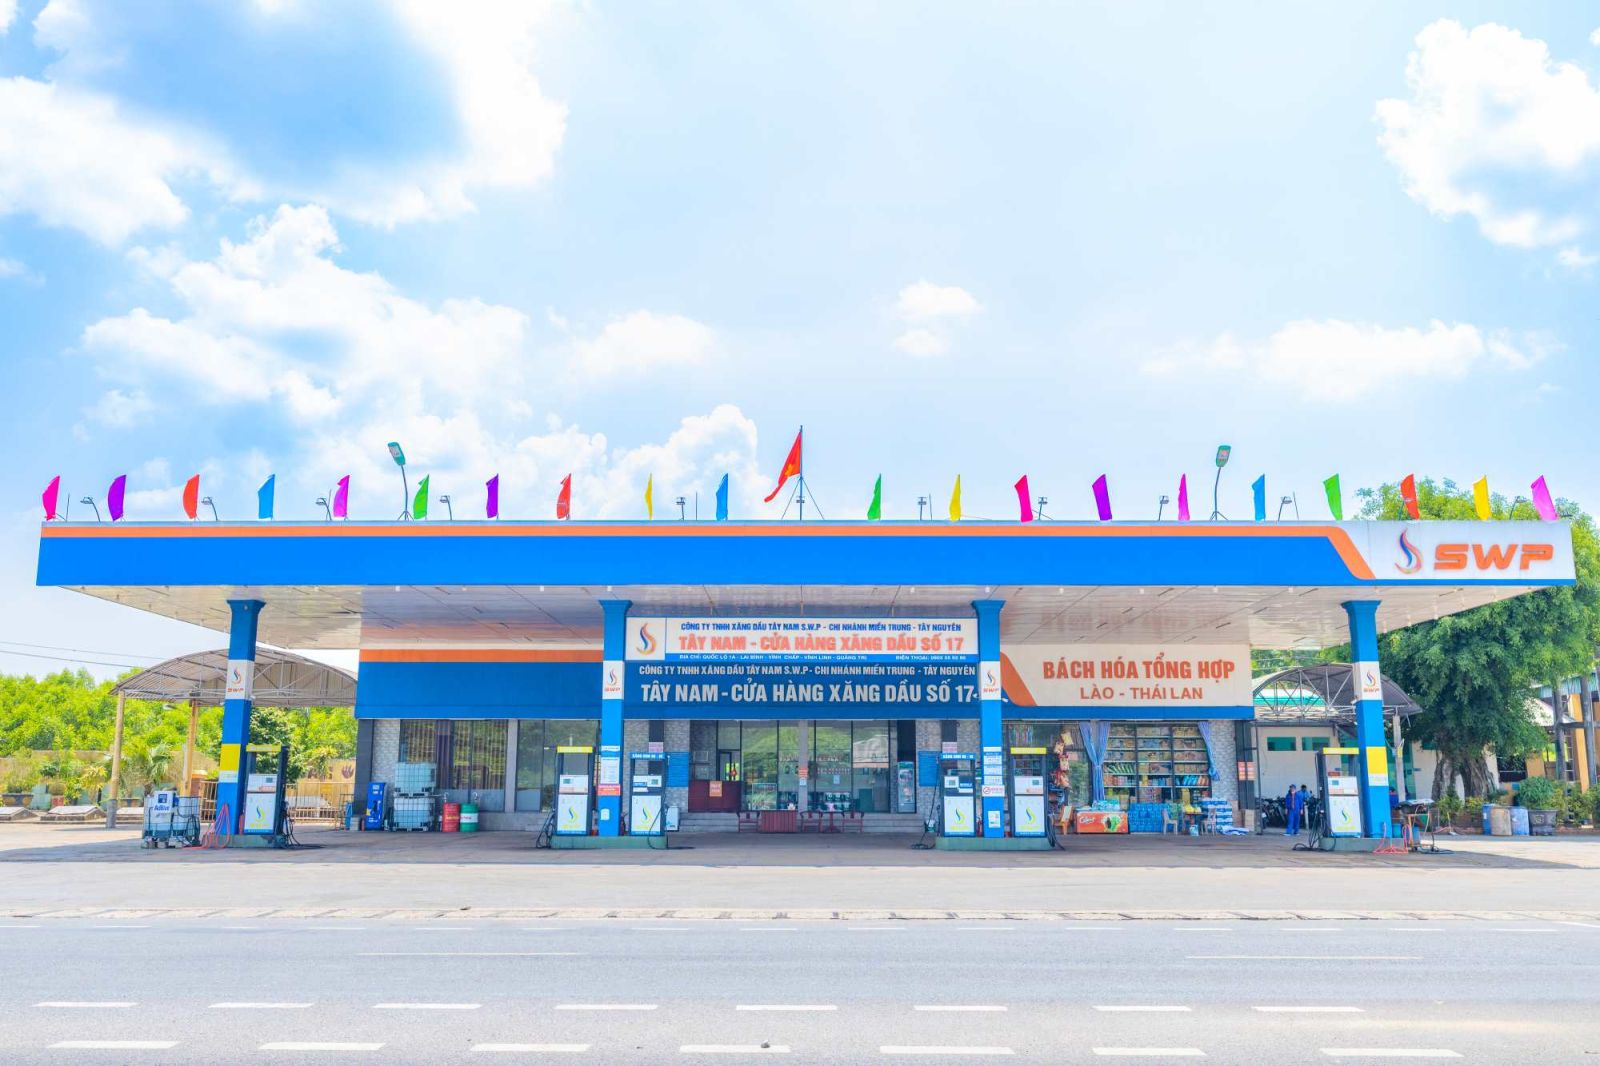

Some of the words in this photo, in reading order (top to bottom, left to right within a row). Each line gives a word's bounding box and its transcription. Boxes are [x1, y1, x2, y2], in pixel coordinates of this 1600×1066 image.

[1434, 543, 1554, 570] SWP
[681, 622, 700, 631] CÔNG
[701, 622, 710, 631] TY
[712, 622, 730, 631] TNHH
[731, 622, 751, 631] XĂNG
[768, 622, 781, 631] TÂY
[783, 622, 799, 631] NAM
[801, 622, 821, 631] S.W.P
[828, 622, 840, 631] CHI
[842, 622, 867, 631] NHÁNH
[888, 622, 911, 631] TRUNG
[917, 622, 931, 631] TÂY
[932, 622, 961, 631] NGUYÊN
[679, 633, 706, 650] TÂY
[711, 636, 747, 650] NAM
[760, 632, 791, 651] CỬA
[795, 633, 837, 651] HÀNG
[840, 633, 883, 651] XĂNG
[920, 633, 943, 651] SỐ
[946, 637, 964, 651] 17
[639, 665, 662, 675] CÔNG
[664, 665, 675, 675] TY
[677, 665, 700, 675] TNHH
[701, 665, 725, 675] XĂNG
[746, 665, 760, 675] TÂY
[761, 665, 782, 675] NAM
[814, 665, 830, 675] CHI
[831, 665, 861, 675] NHÁNH
[886, 665, 915, 675] TRUNG
[923, 665, 937, 675] TÂY
[939, 665, 976, 675] NGUYÊN
[1043, 657, 1096, 680] BÁCH
[1101, 656, 1139, 679] HÓA
[1142, 652, 1192, 679] TỔNG
[1198, 659, 1236, 683] HỢP
[641, 680, 671, 702] TÂY
[675, 684, 719, 702] NAM
[731, 678, 768, 702] CỬA
[773, 680, 824, 702] HÀNG
[829, 681, 880, 702] XĂNG
[885, 679, 922, 702] DẦU
[926, 679, 951, 702] SỐ
[955, 685, 975, 702] 17
[1080, 685, 1114, 700] LÀO
[1130, 685, 1167, 700] THÁI
[1171, 687, 1203, 699] LAN
